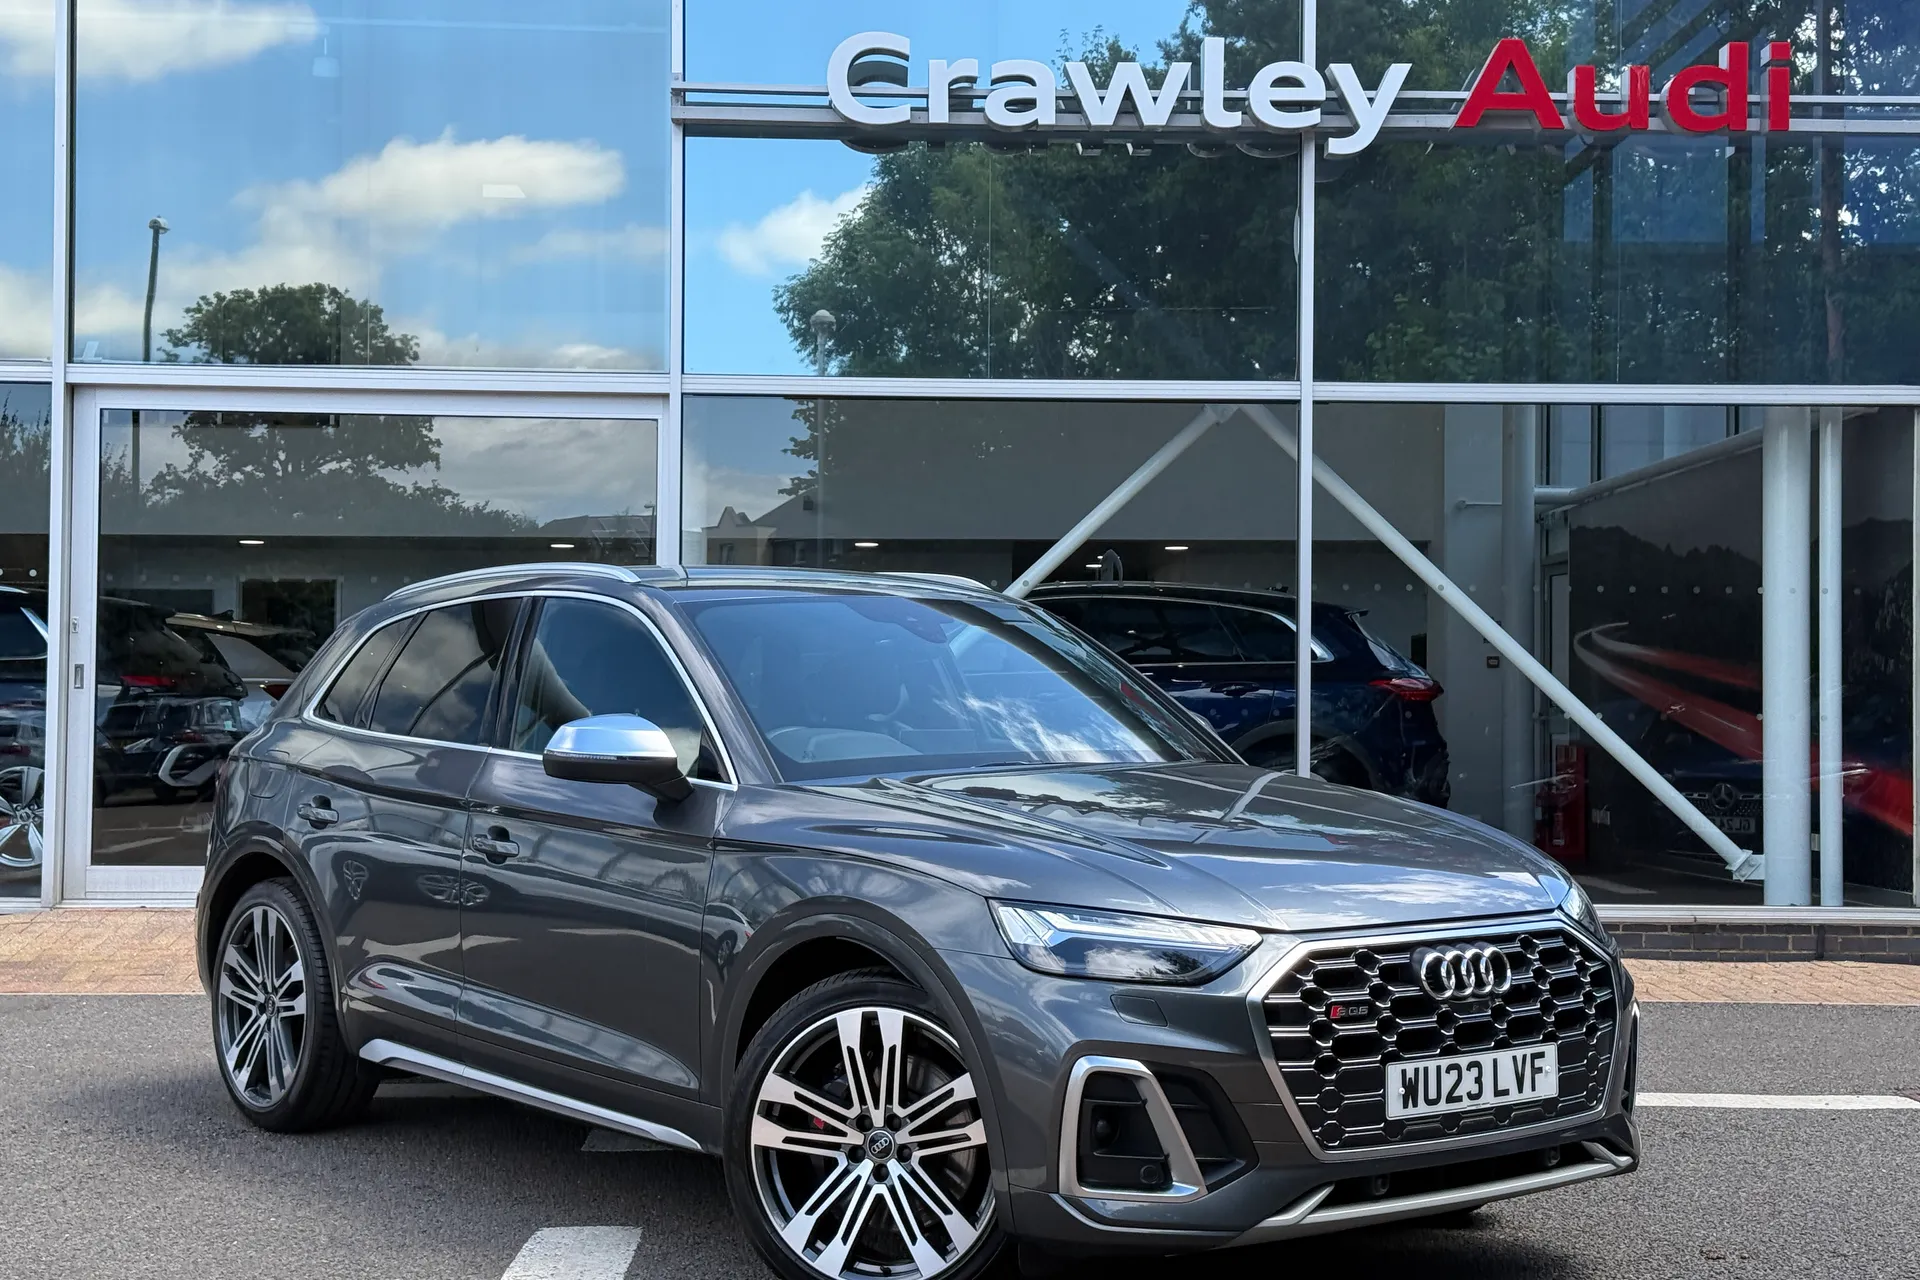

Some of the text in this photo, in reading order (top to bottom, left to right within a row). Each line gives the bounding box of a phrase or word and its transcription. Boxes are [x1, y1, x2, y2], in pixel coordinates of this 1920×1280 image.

[827, 31, 1791, 157] Crawley Audi
[1400, 1051, 1546, 1110] WU23 LVF
